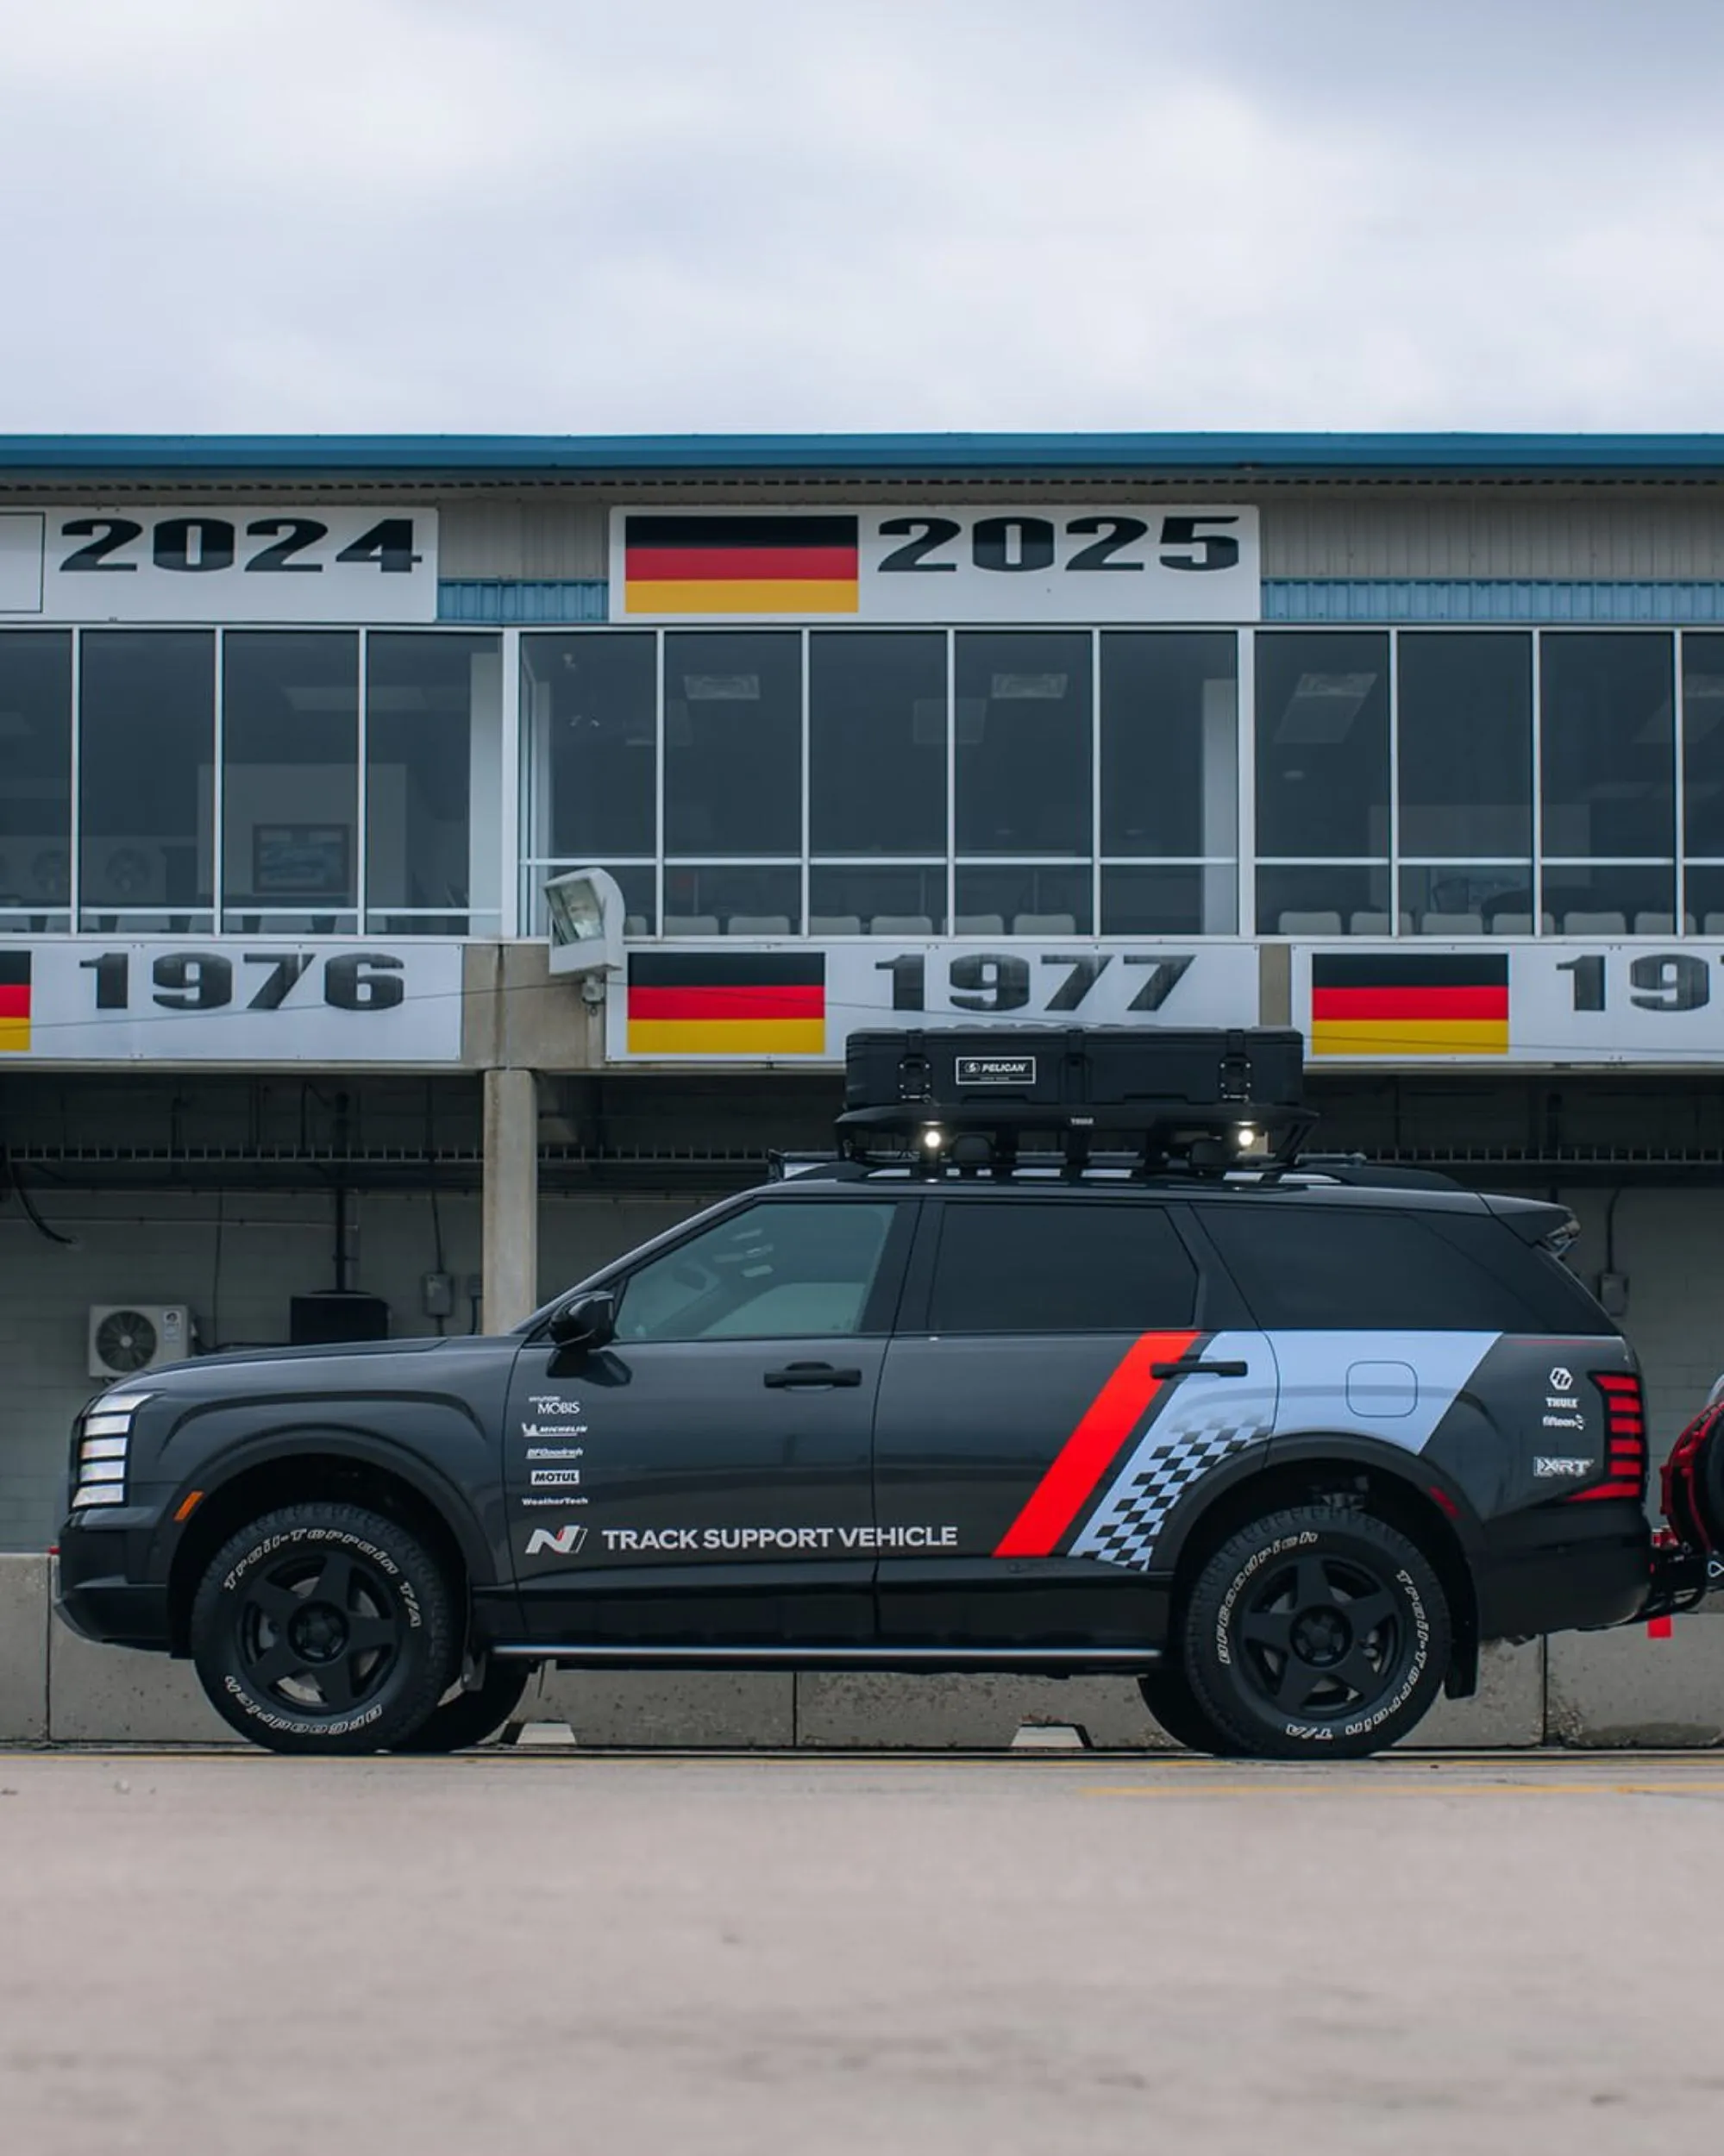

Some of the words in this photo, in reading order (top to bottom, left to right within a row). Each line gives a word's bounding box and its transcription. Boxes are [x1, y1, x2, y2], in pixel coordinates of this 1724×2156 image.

[60, 517, 423, 573] 2024
[878, 515, 1240, 572] 2025
[79, 953, 404, 1011] 1976
[875, 955, 1195, 1012] 1977
[1557, 955, 1724, 1012] 19
[982, 1062, 1026, 1073] PELICAN
[537, 1402, 580, 1414] MOBIS
[1545, 1397, 1577, 1408] THULE
[535, 1472, 577, 1482] MOTUL
[522, 1497, 588, 1506] WeatherTech
[602, 1529, 699, 1550] TRACK
[703, 1528, 834, 1549] SUPPORT
[839, 1526, 958, 1548] VEHICLE
[399, 1582, 423, 1628] T/A
[1286, 1723, 1333, 1740] T/A
